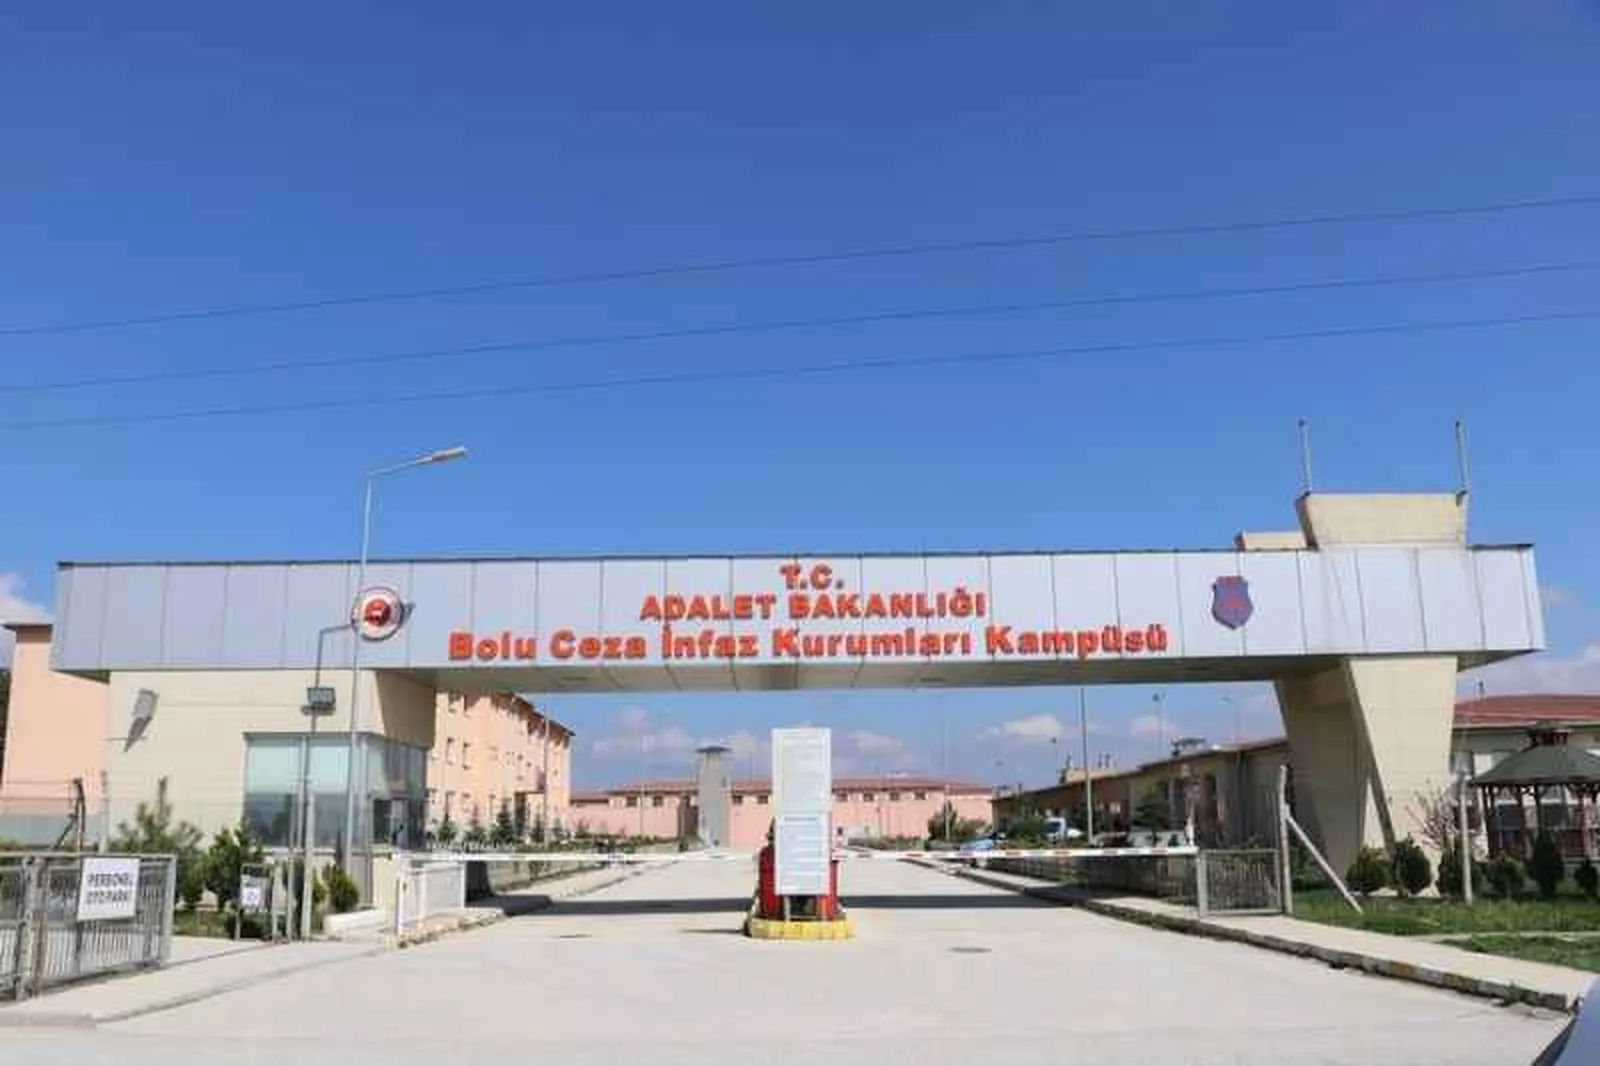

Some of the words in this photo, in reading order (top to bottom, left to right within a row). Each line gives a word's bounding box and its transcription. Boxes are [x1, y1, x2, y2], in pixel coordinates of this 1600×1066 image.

[779, 563, 845, 590] T.C.
[640, 592, 776, 620] ADALET
[787, 587, 987, 619] BAKANLIĞI
[448, 631, 538, 660] Bolu
[550, 629, 648, 659] Ceza
[660, 625, 760, 660] İnfaz
[771, 627, 973, 657] Kurumları
[984, 624, 1168, 661] Kampüsü
